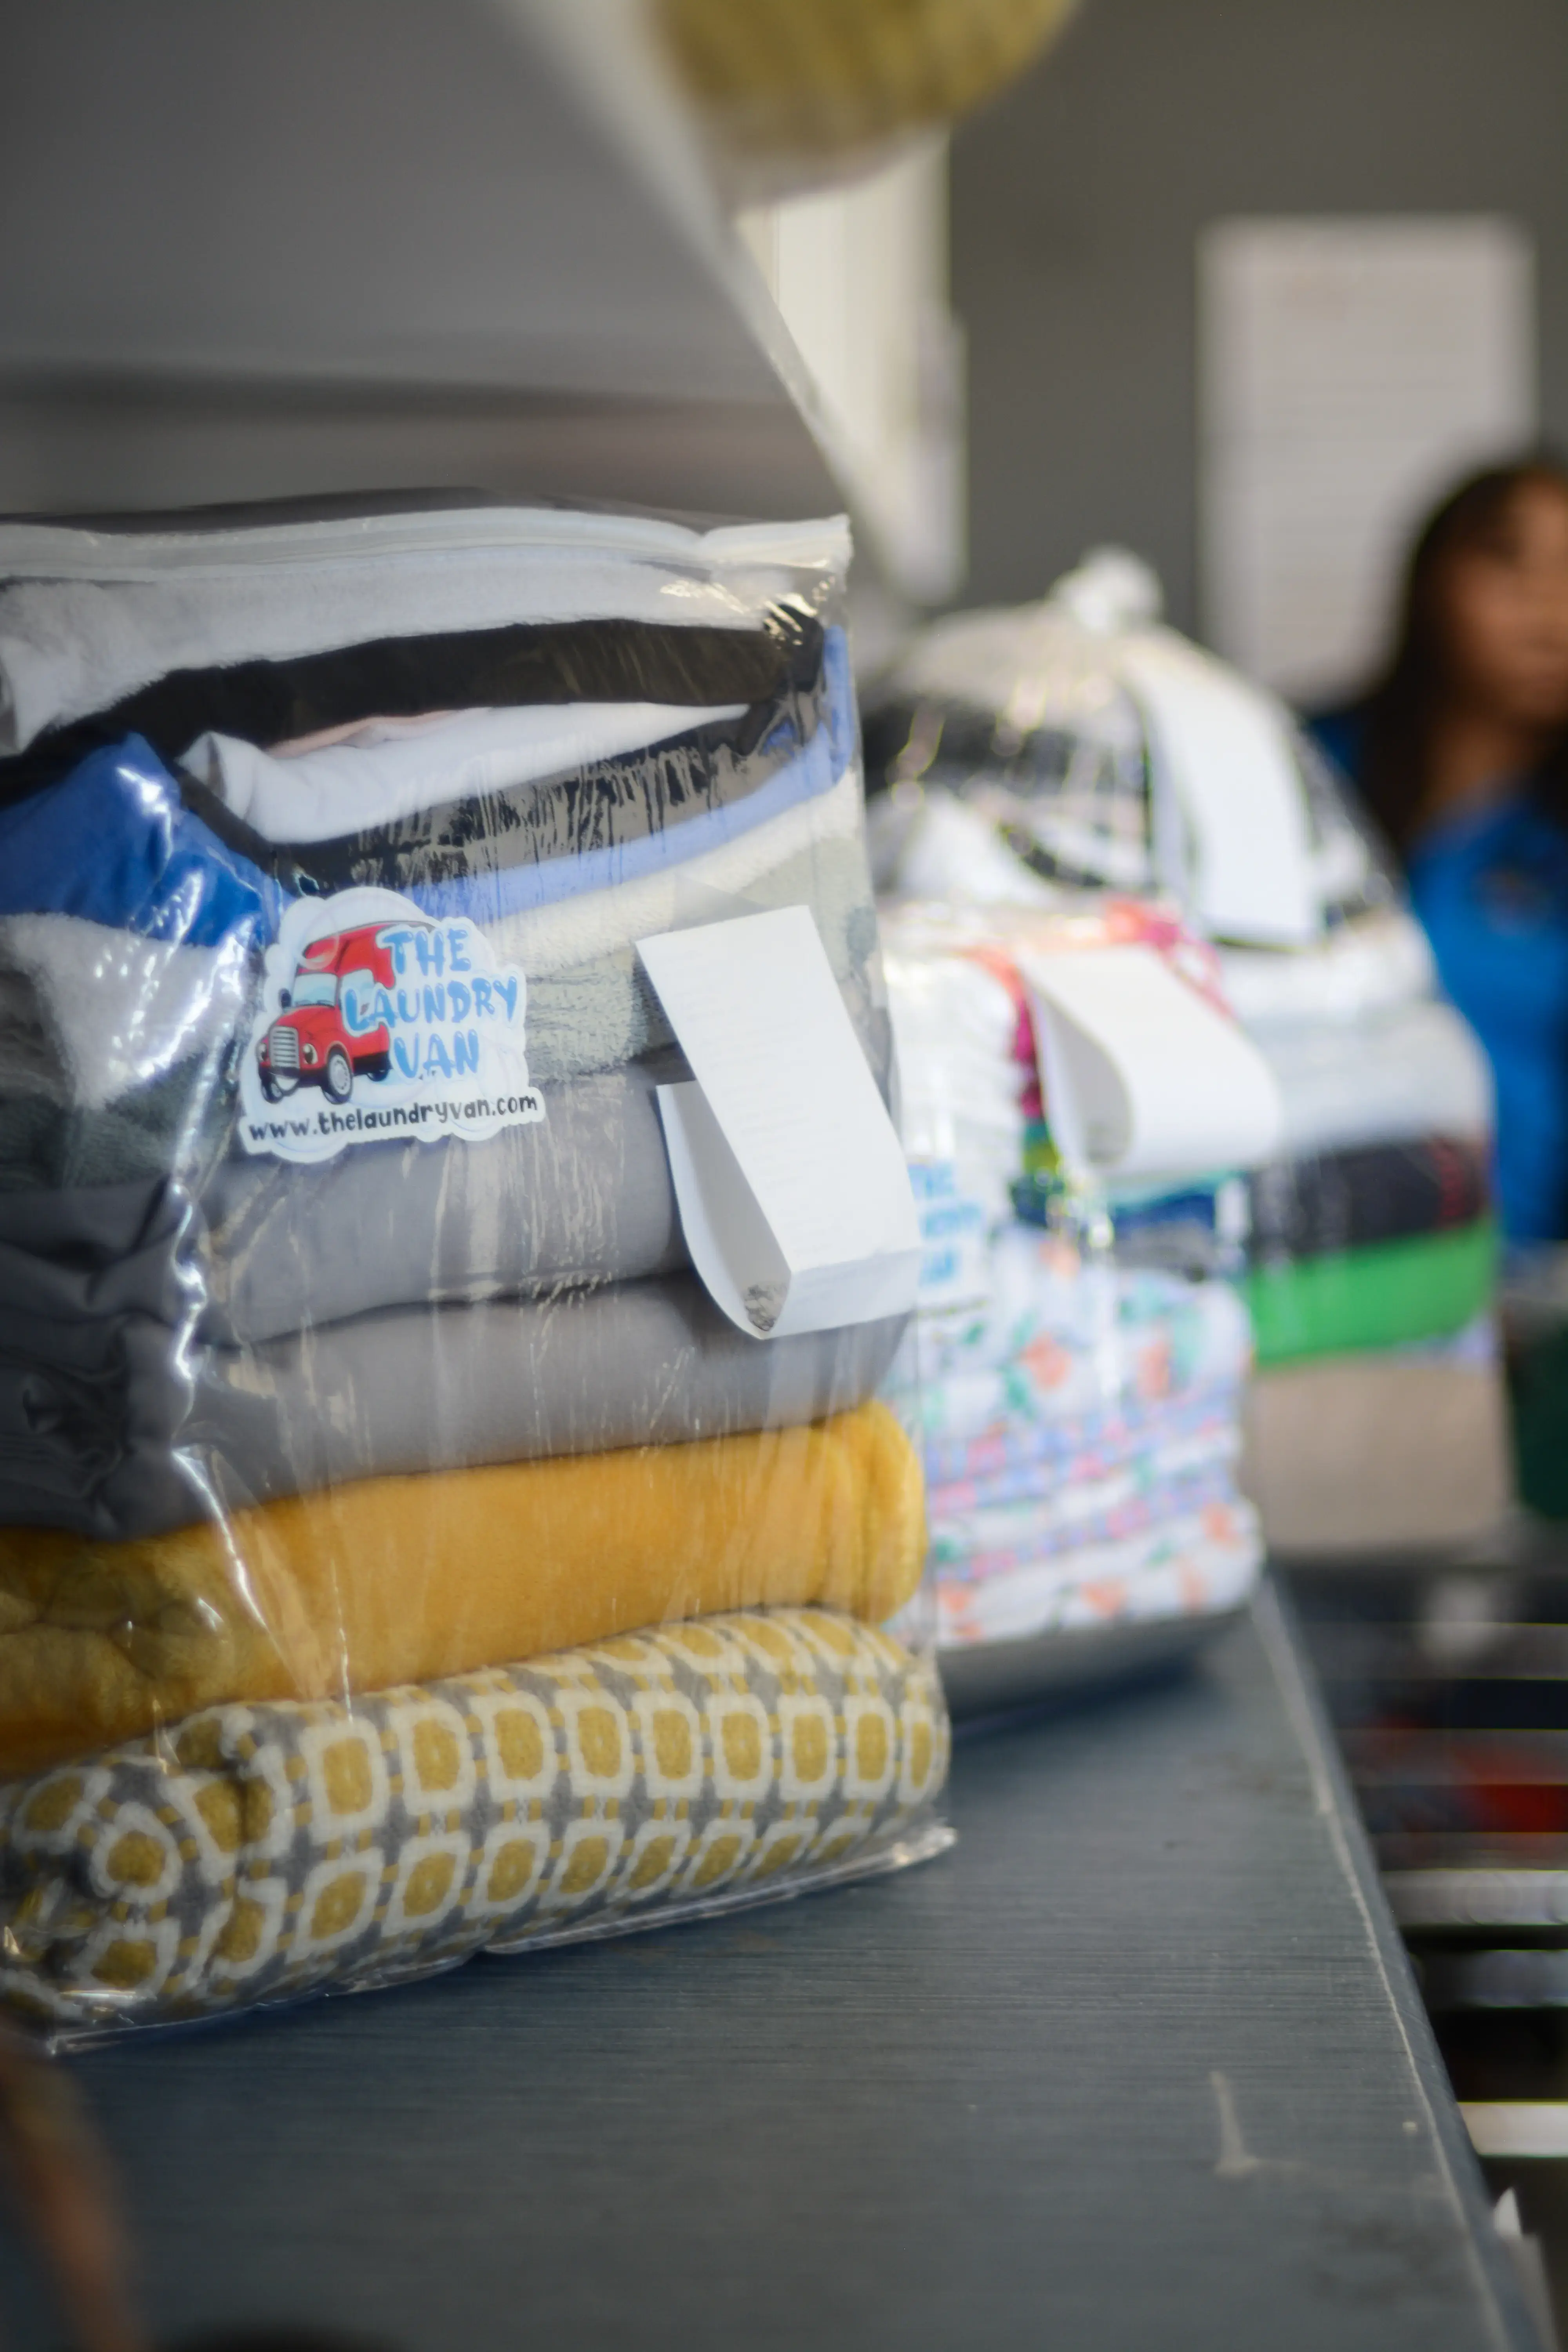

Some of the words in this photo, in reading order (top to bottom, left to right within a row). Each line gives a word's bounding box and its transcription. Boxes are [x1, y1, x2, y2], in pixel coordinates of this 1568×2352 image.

[383, 929, 470, 976] THE
[345, 976, 517, 1031] LAUNDRY
[394, 1029, 479, 1078] VAN
[249, 1095, 537, 1140] www.thelaundryvan.com
